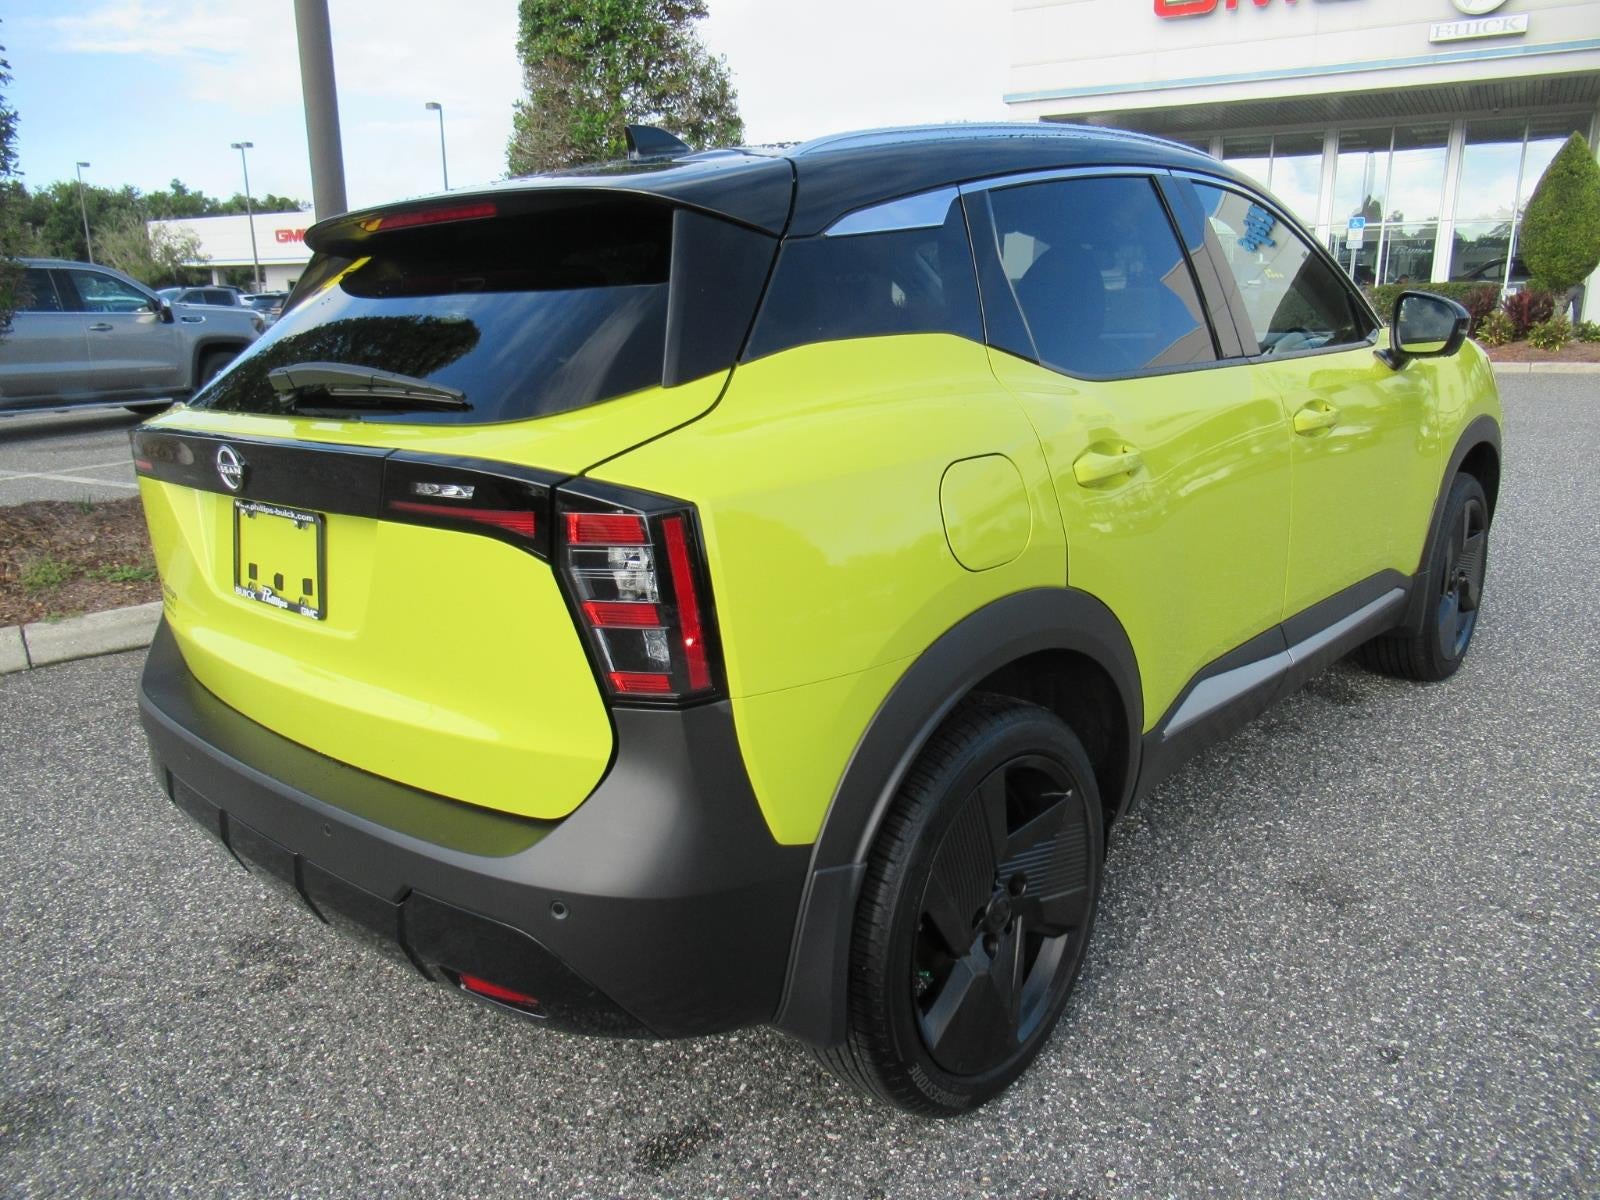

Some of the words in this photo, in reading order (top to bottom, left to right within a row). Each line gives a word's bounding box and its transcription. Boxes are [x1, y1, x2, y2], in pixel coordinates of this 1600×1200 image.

[1432, 17, 1524, 38] BUICK
[275, 229, 305, 243] GM
[235, 586, 256, 600] BUICK
[260, 587, 288, 608] Phillips
[300, 606, 319, 620] GMC
